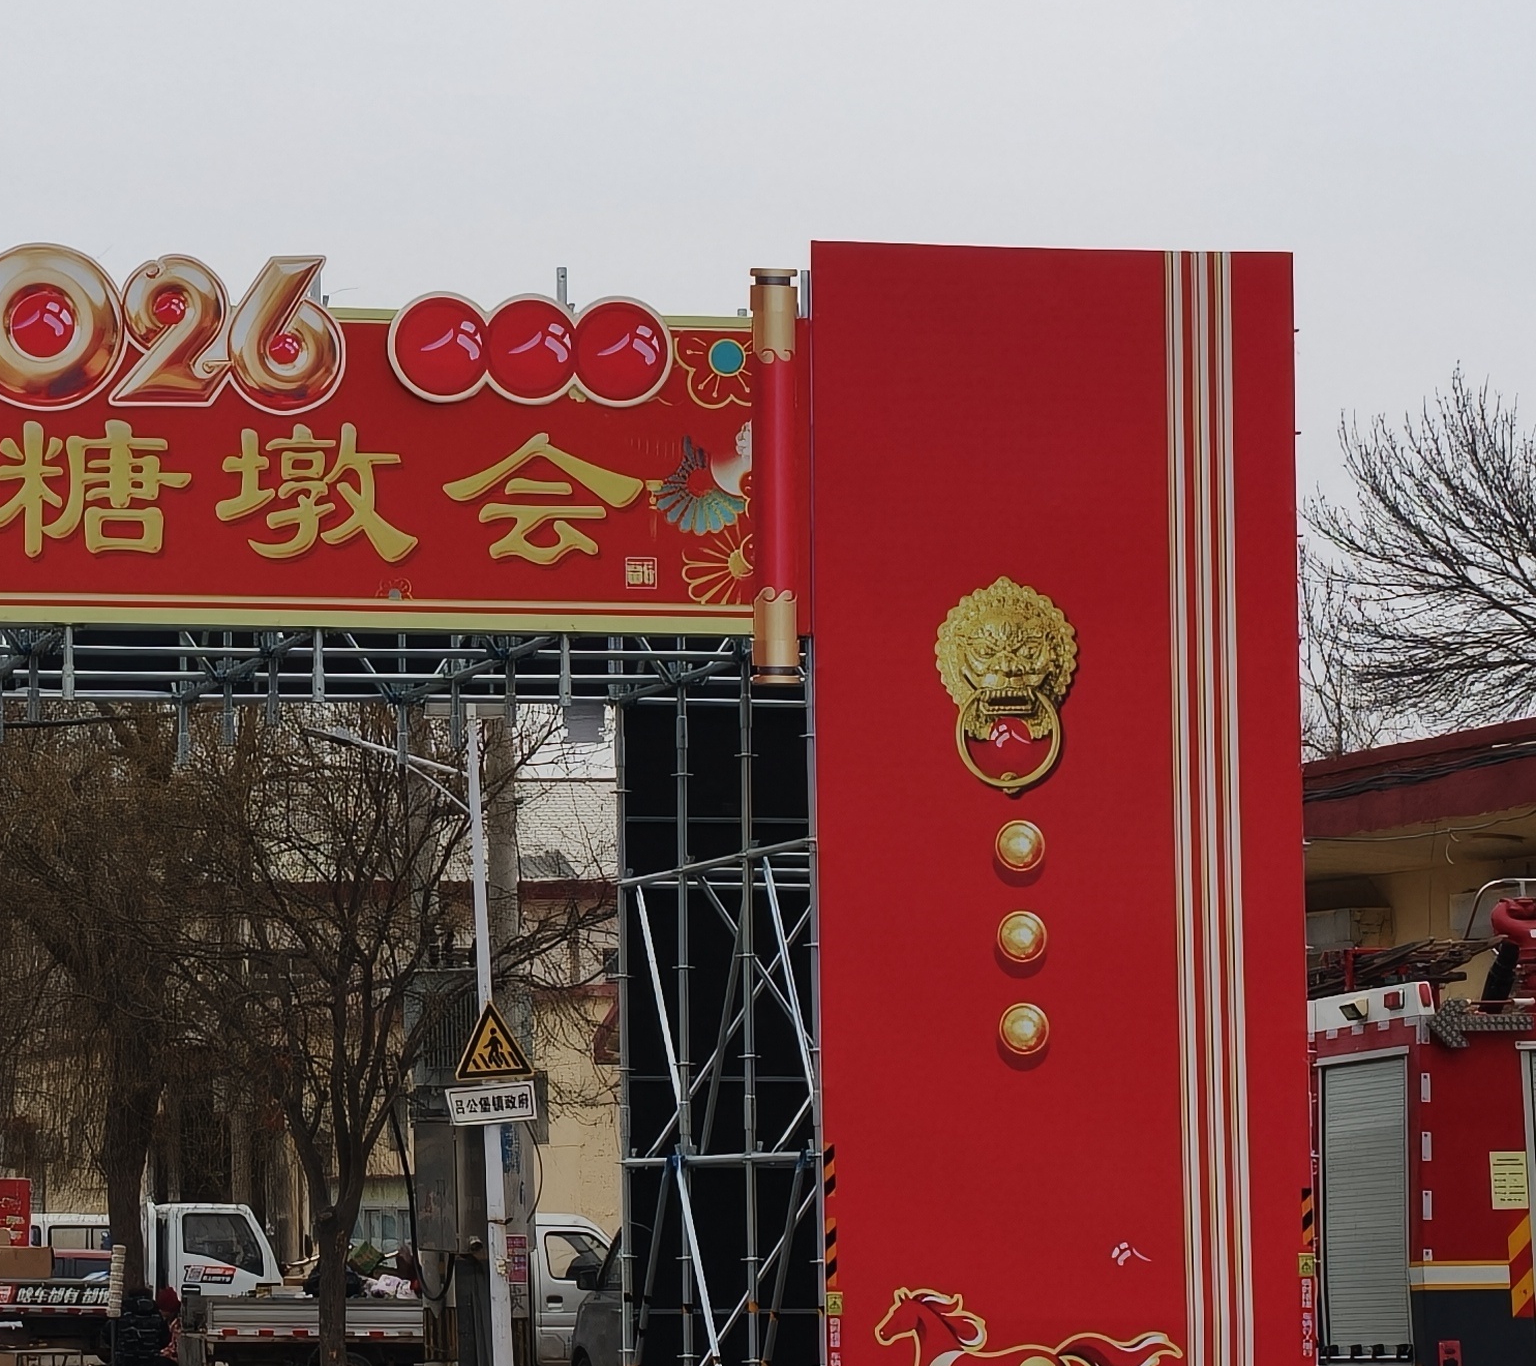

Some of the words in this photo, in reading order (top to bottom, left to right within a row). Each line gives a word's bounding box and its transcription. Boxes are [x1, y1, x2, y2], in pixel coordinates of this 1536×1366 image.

[455, 1092, 529, 1115] 吕公堡镇政府
